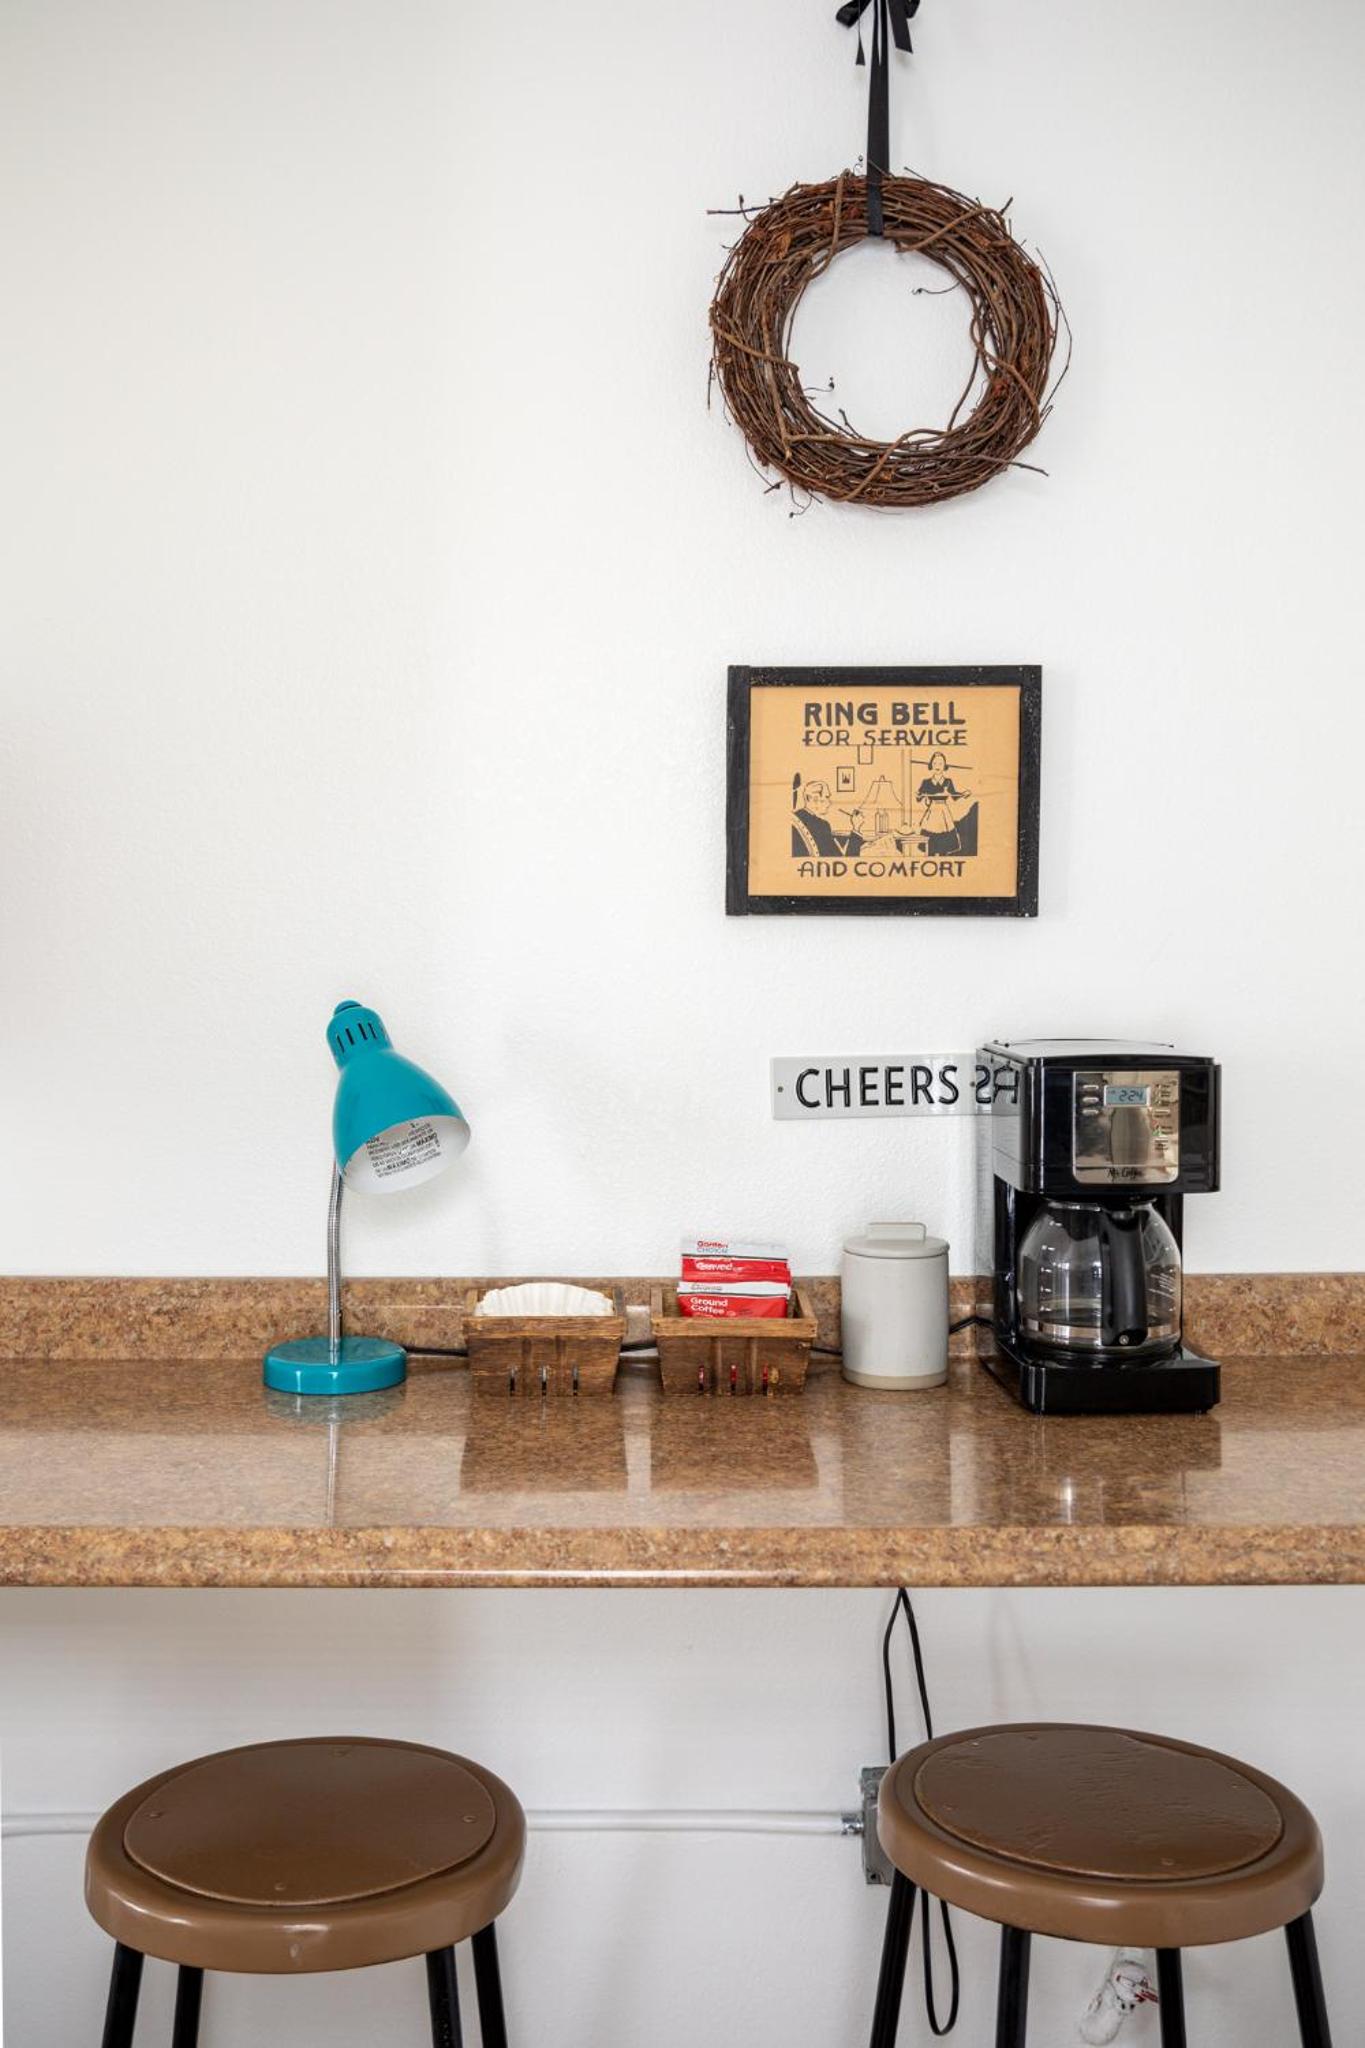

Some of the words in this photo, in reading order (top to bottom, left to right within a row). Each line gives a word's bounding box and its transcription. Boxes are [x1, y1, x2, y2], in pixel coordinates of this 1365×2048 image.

[804, 701, 878, 727] RING
[891, 701, 966, 725] BELL
[802, 729, 850, 746] FOR
[863, 729, 968, 746] SERVICE
[797, 860, 848, 878] AND
[854, 860, 966, 877] COMFORT
[795, 1065, 960, 1108] CHEERS
[690, 1297, 729, 1306] Ground
[690, 1304, 725, 1314] Coffee
